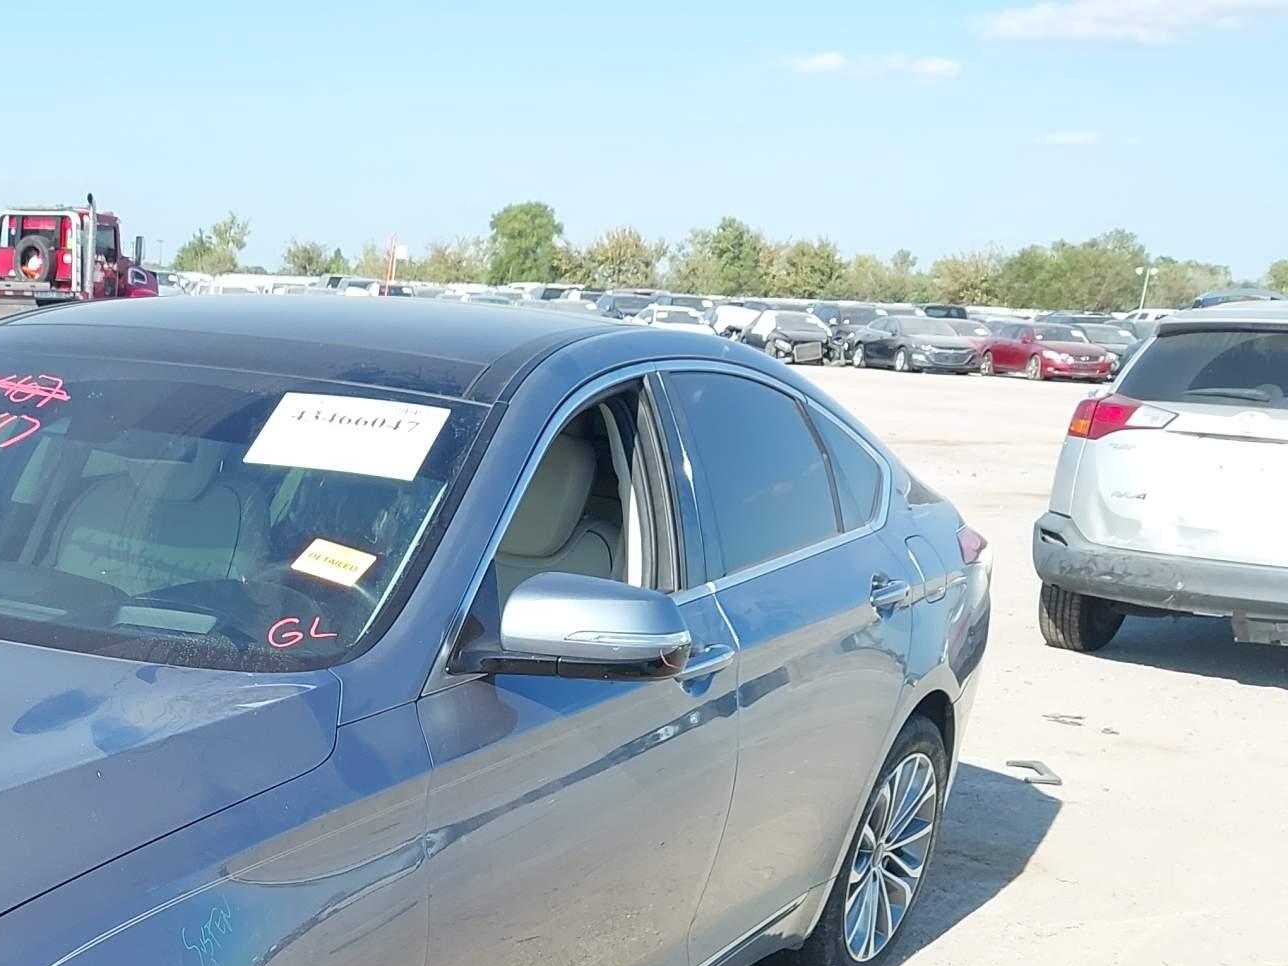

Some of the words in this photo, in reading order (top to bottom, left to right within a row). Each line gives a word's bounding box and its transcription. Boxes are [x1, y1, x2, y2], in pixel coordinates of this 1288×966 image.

[290, 409, 421, 433] 43466047
[307, 551, 359, 573] DETAILED
[267, 616, 338, 648] GL
